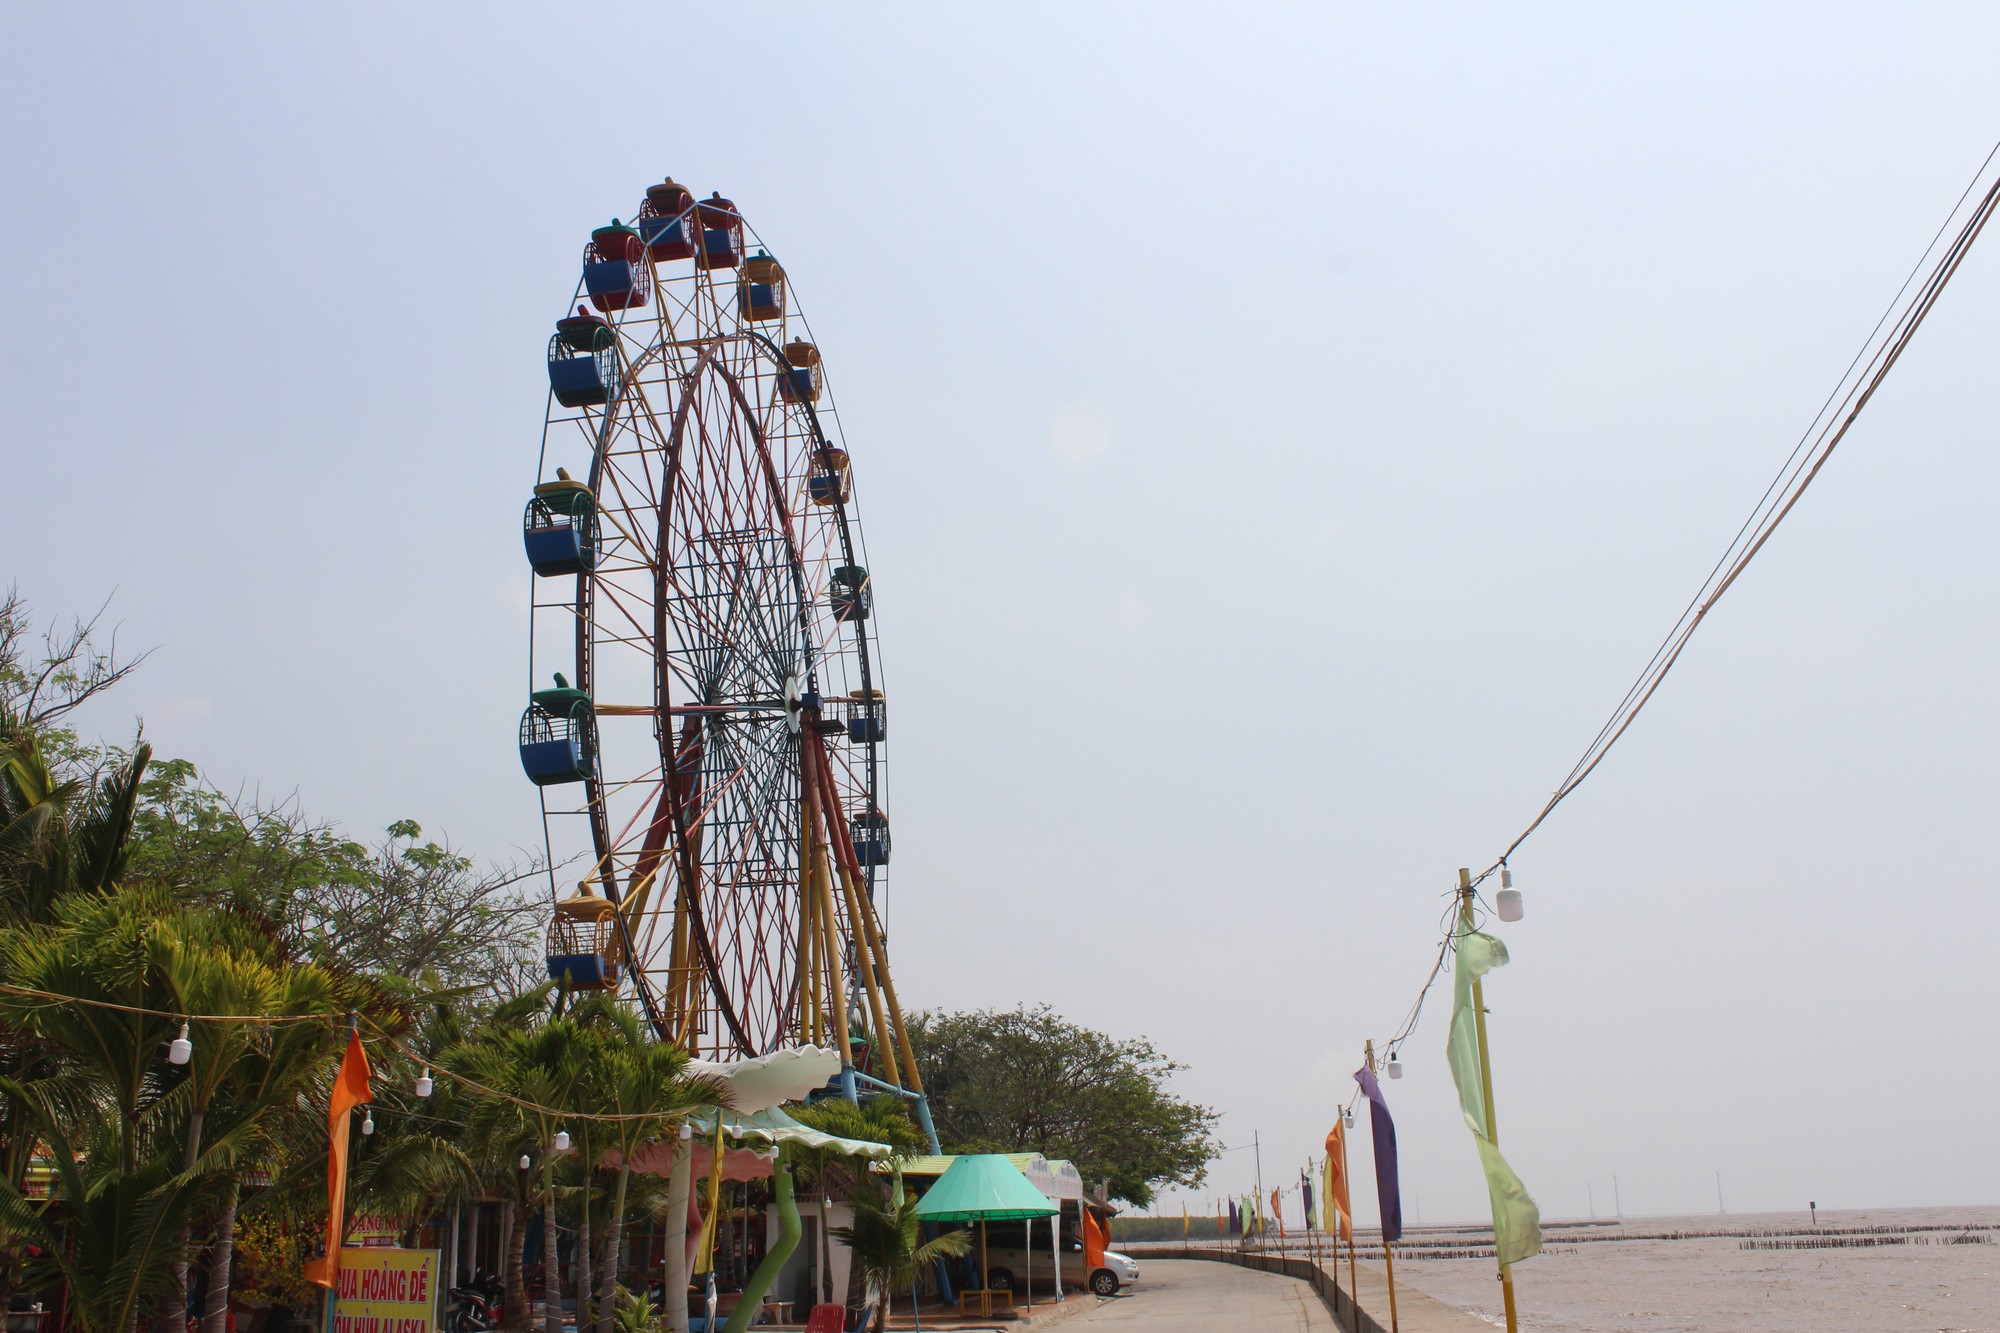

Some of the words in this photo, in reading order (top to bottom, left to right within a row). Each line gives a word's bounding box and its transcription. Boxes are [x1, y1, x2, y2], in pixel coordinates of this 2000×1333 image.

[361, 1259, 407, 1303] HOÀNG
[409, 1256, 431, 1304] ĐẾ
[334, 1307, 351, 1333] ÔM
